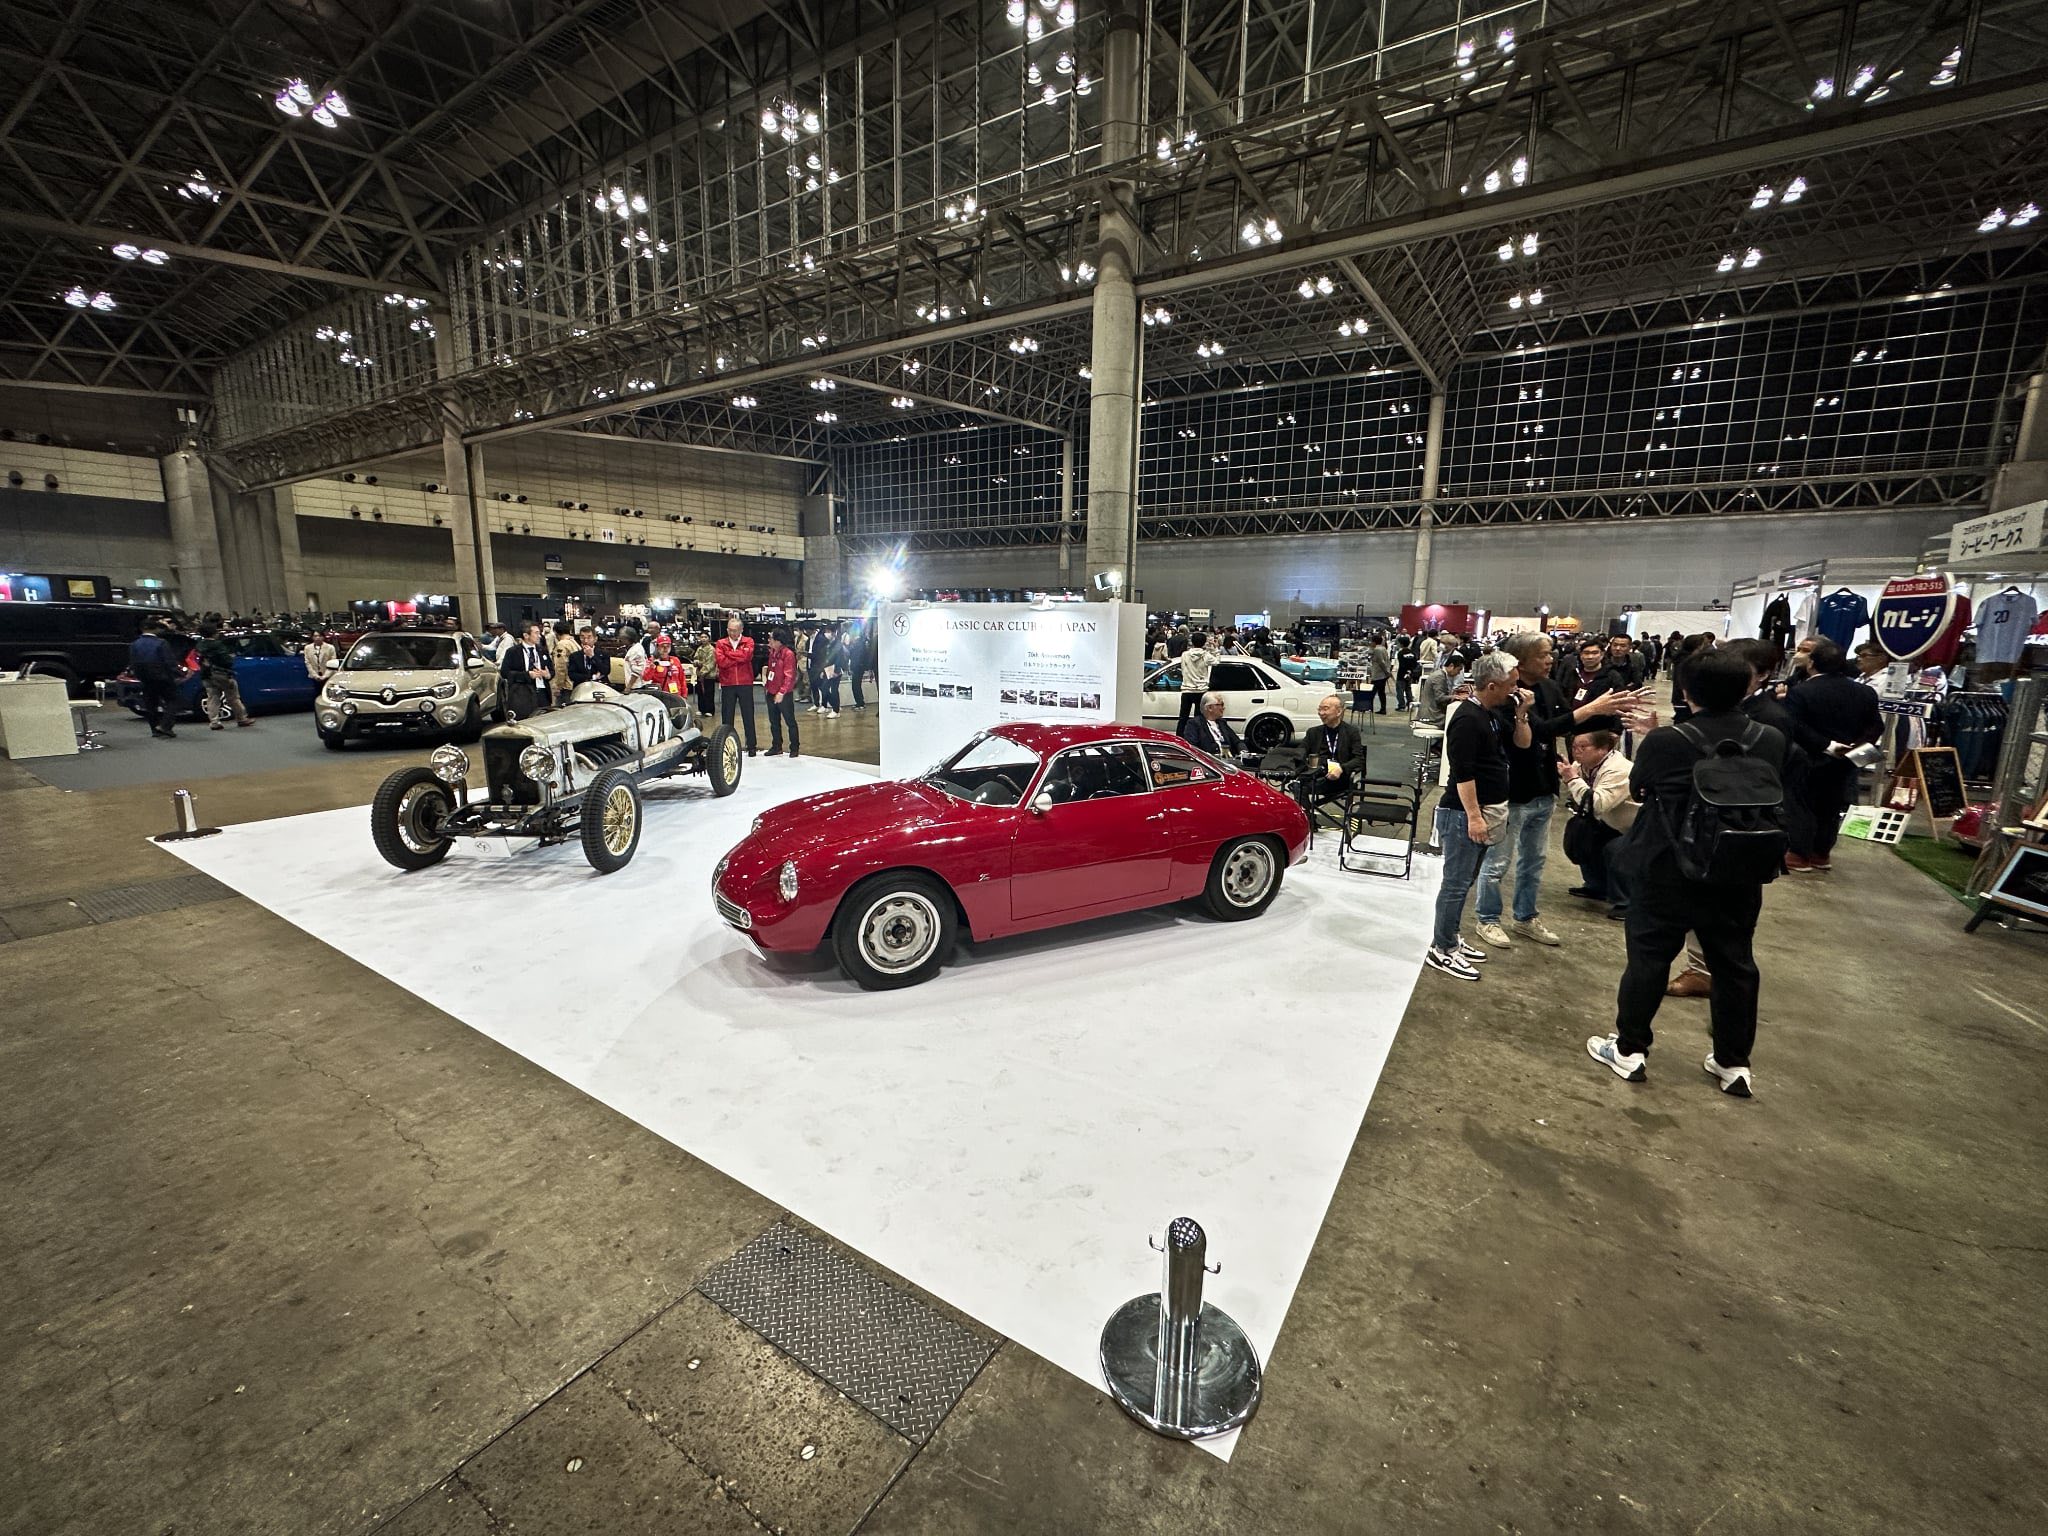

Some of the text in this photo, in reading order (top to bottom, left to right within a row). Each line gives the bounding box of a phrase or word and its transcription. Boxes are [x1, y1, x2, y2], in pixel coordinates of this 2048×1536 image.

[1896, 581, 1944, 592] 0120-182-515
[1994, 609, 2010, 624] 20
[942, 620, 980, 631] LASSIC
[983, 621, 1005, 631] CAR
